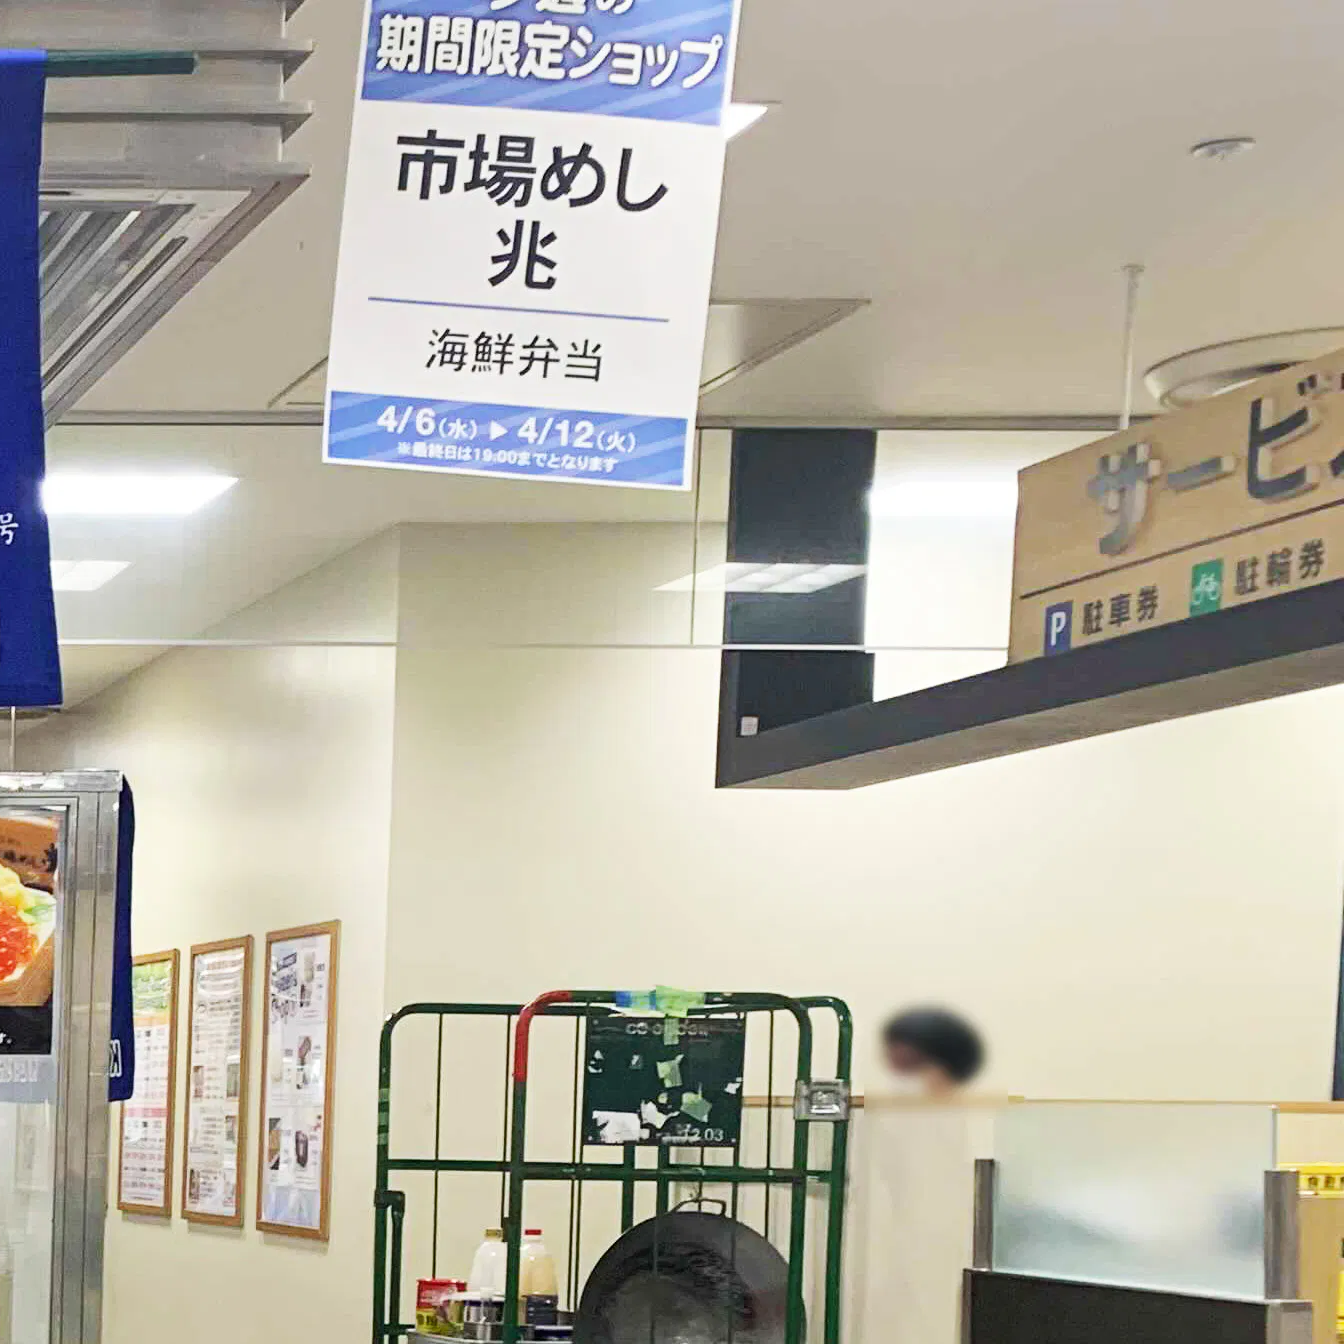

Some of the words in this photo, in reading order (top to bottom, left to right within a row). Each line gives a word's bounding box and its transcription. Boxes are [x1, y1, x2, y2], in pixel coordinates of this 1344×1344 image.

[375, 13, 725, 89] 期間限定ショップ
[396, 129, 669, 213] 市場めし
[488, 219, 559, 290] 兆
[425, 327, 603, 382] 海鮮弁当
[1086, 372, 1344, 556] サービ
[1234, 538, 1326, 597] 駐輪券
[1081, 586, 1159, 638] 駐車券
